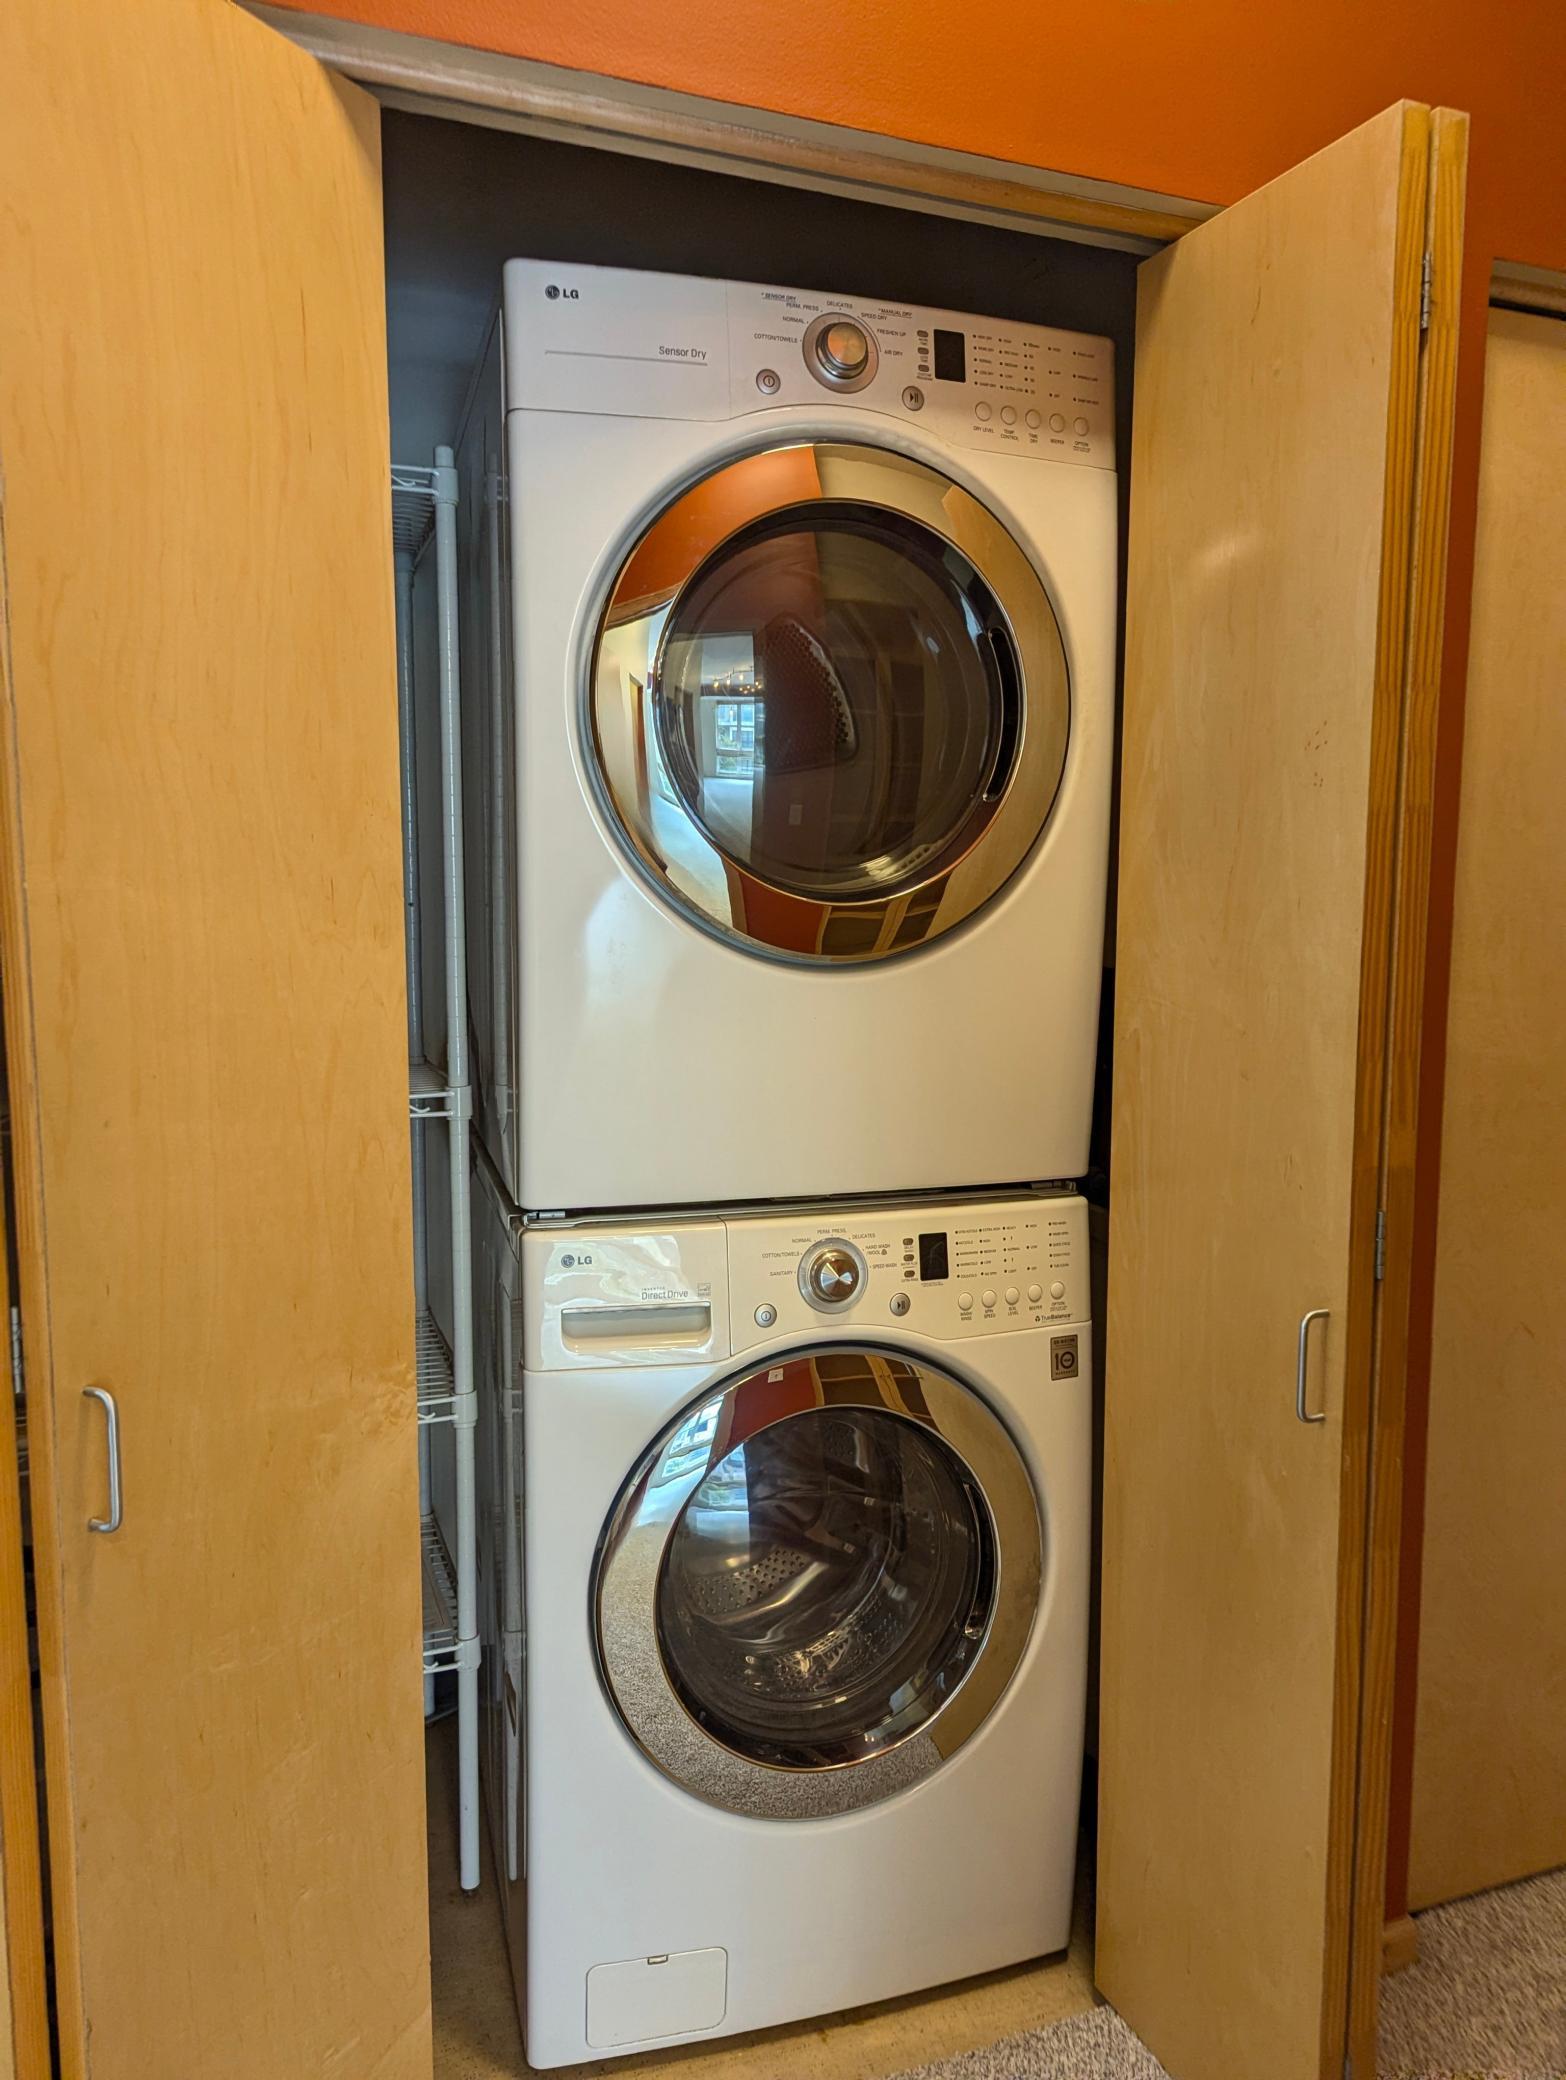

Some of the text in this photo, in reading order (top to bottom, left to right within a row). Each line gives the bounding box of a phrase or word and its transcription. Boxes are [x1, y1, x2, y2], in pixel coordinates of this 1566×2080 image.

[563, 288, 579, 300] LG
[827, 300, 853, 309] DELICATES
[782, 315, 804, 324] NORMAL
[659, 345, 707, 360] Sensor Dry
[577, 1256, 593, 1265] LG
[1055, 1351, 1075, 1371] 10
